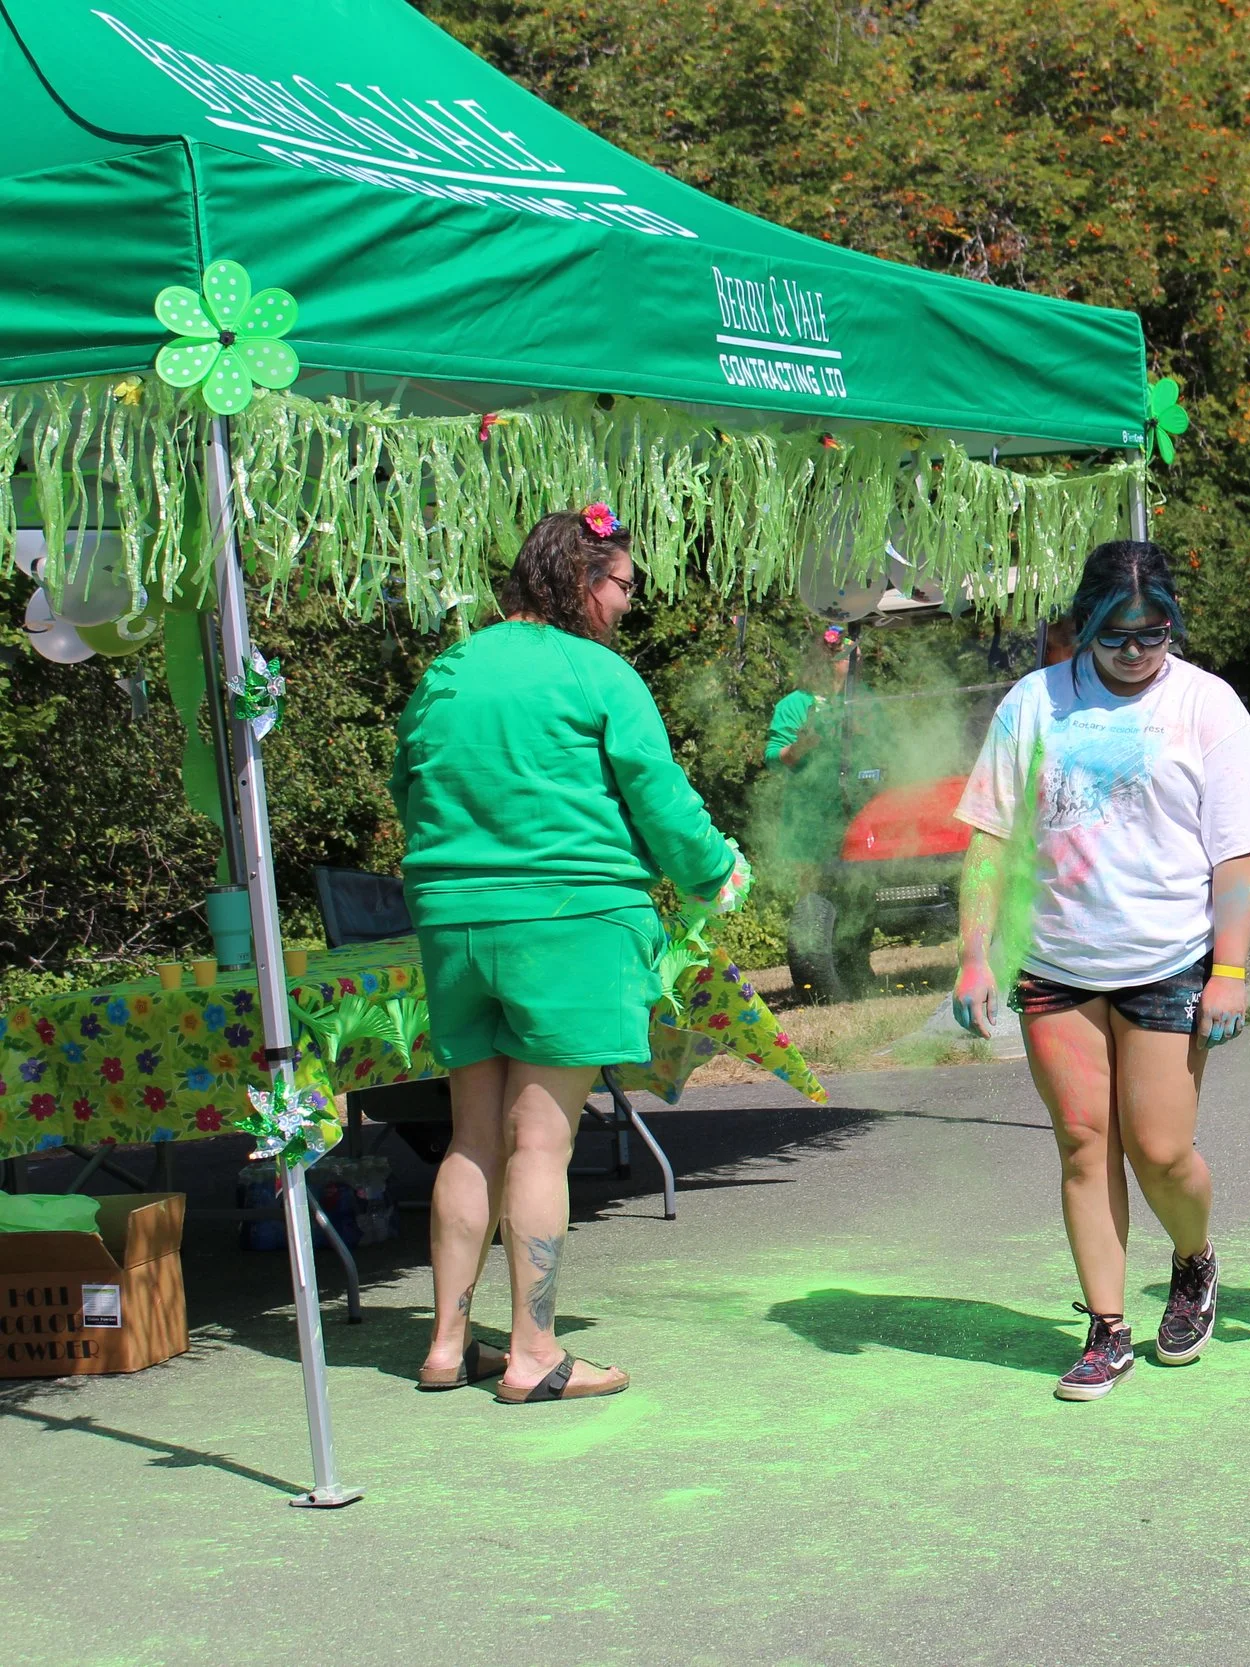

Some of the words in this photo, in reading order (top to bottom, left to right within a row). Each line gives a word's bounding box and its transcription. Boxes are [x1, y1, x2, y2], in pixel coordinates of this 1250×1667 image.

[90, 9, 372, 150] BERRY
[335, 82, 566, 174] VALE
[583, 202, 700, 239] LTD
[711, 265, 771, 335] BERRY
[769, 275, 792, 338] &
[782, 278, 830, 343] VALE
[718, 353, 822, 396] CONTRACTING
[819, 366, 848, 398] LTD
[1072, 719, 1106, 732] Rotary
[8, 1286, 69, 1308] HOLI
[0, 1339, 100, 1362] OWDER
